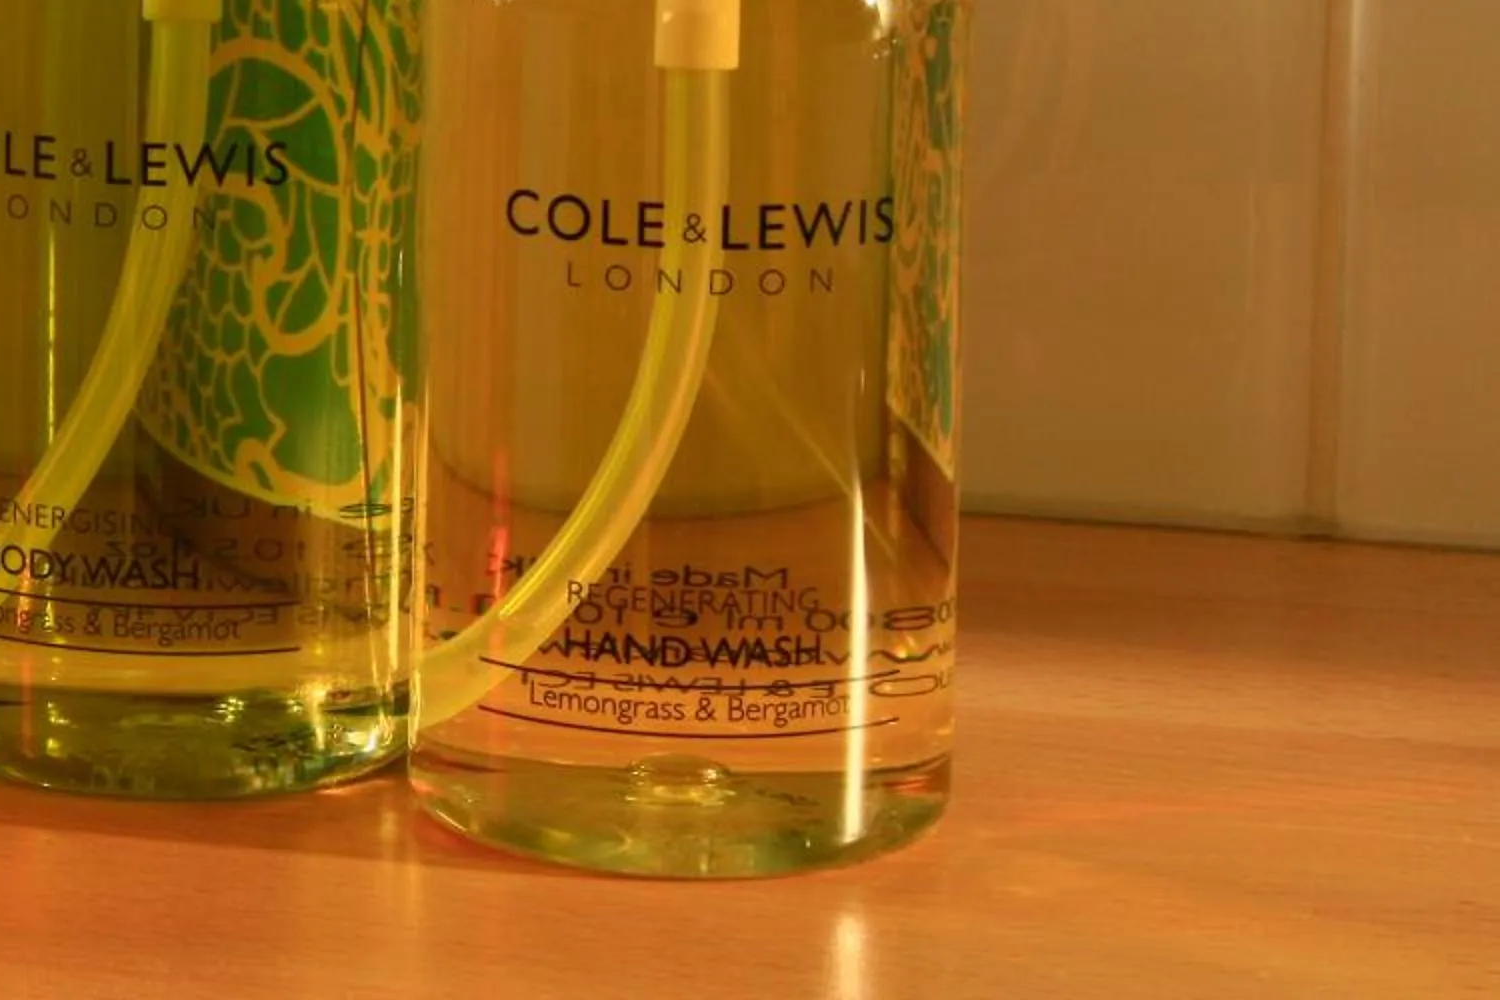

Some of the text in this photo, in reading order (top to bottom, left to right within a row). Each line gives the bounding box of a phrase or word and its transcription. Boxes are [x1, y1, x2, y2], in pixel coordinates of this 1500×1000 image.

[70, 148, 92, 178] &
[105, 140, 289, 187] LEWIS
[506, 189, 894, 250] COLE & LEWIS
[566, 261, 832, 296] LONDON
[80, 551, 199, 590] WASH
[567, 580, 819, 616] REGENERATING
[82, 608, 101, 634] &
[114, 611, 241, 646] Bergamot
[563, 627, 691, 668] HAND
[700, 634, 821, 668] WASH
[529, 679, 850, 728] Lemongrass & Bergamot
